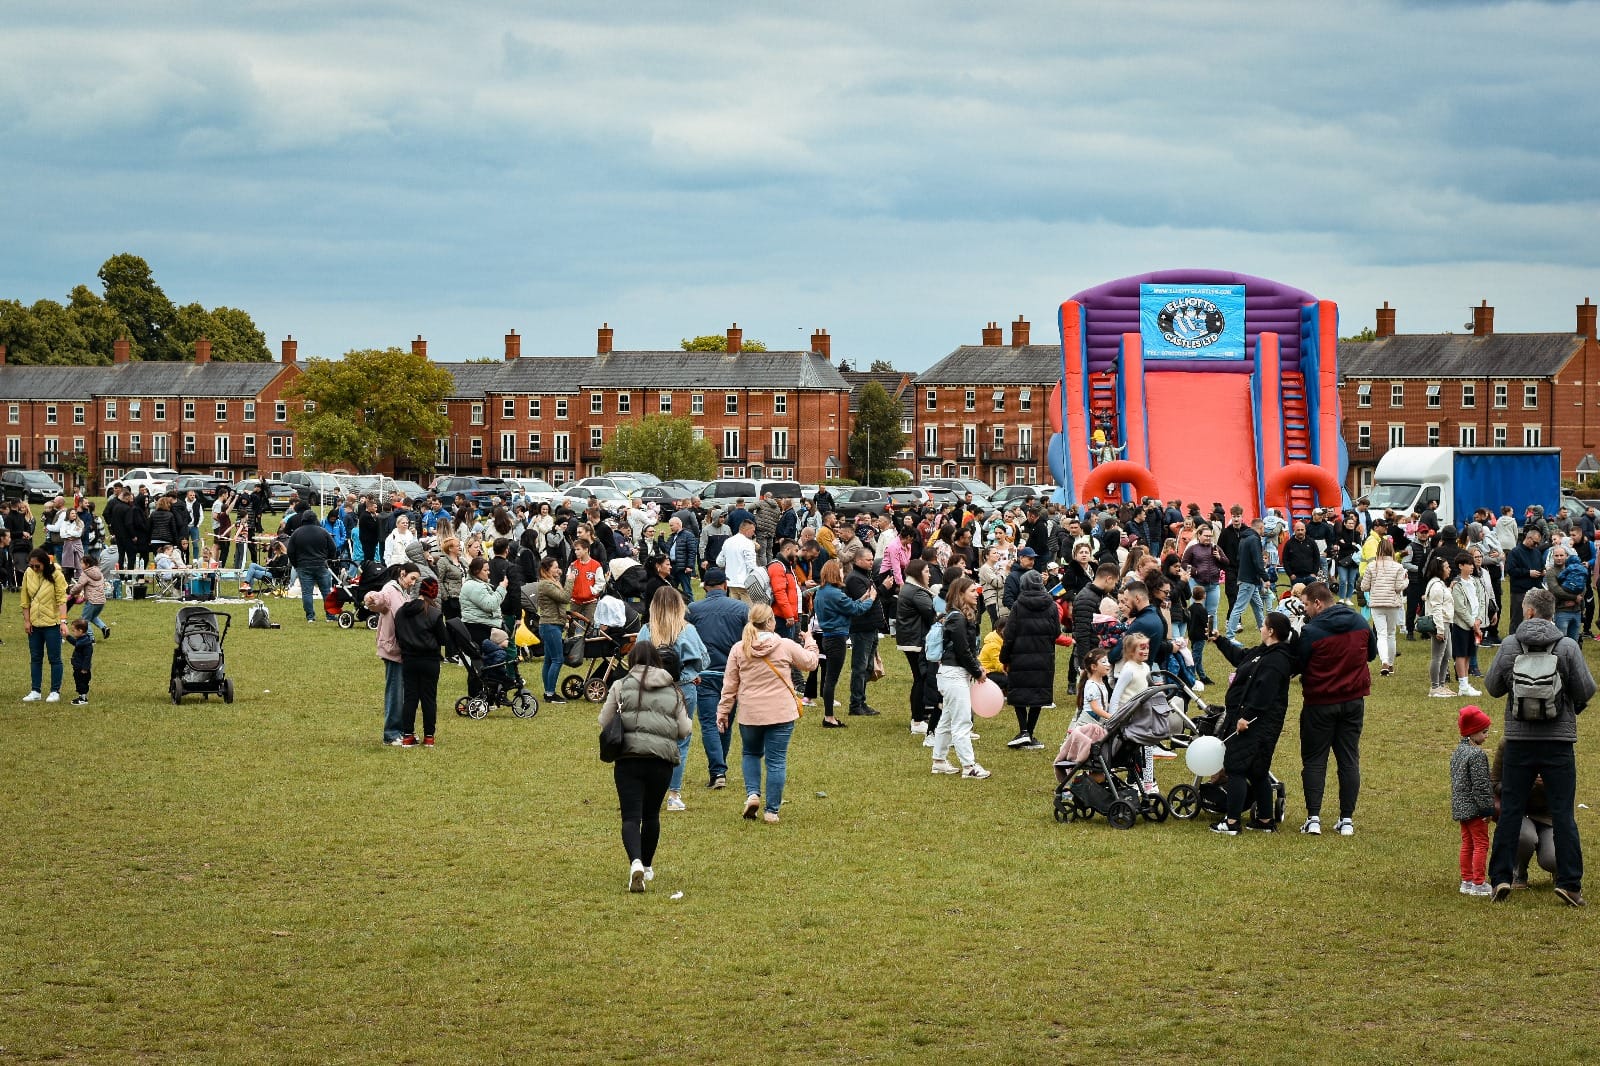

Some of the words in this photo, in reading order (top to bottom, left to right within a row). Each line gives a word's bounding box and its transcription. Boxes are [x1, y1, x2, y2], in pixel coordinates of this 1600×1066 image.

[1165, 298, 1216, 312] ELLIOTTS
[1165, 333, 1202, 348] CASTLES
[1203, 333, 1218, 346] LTD
